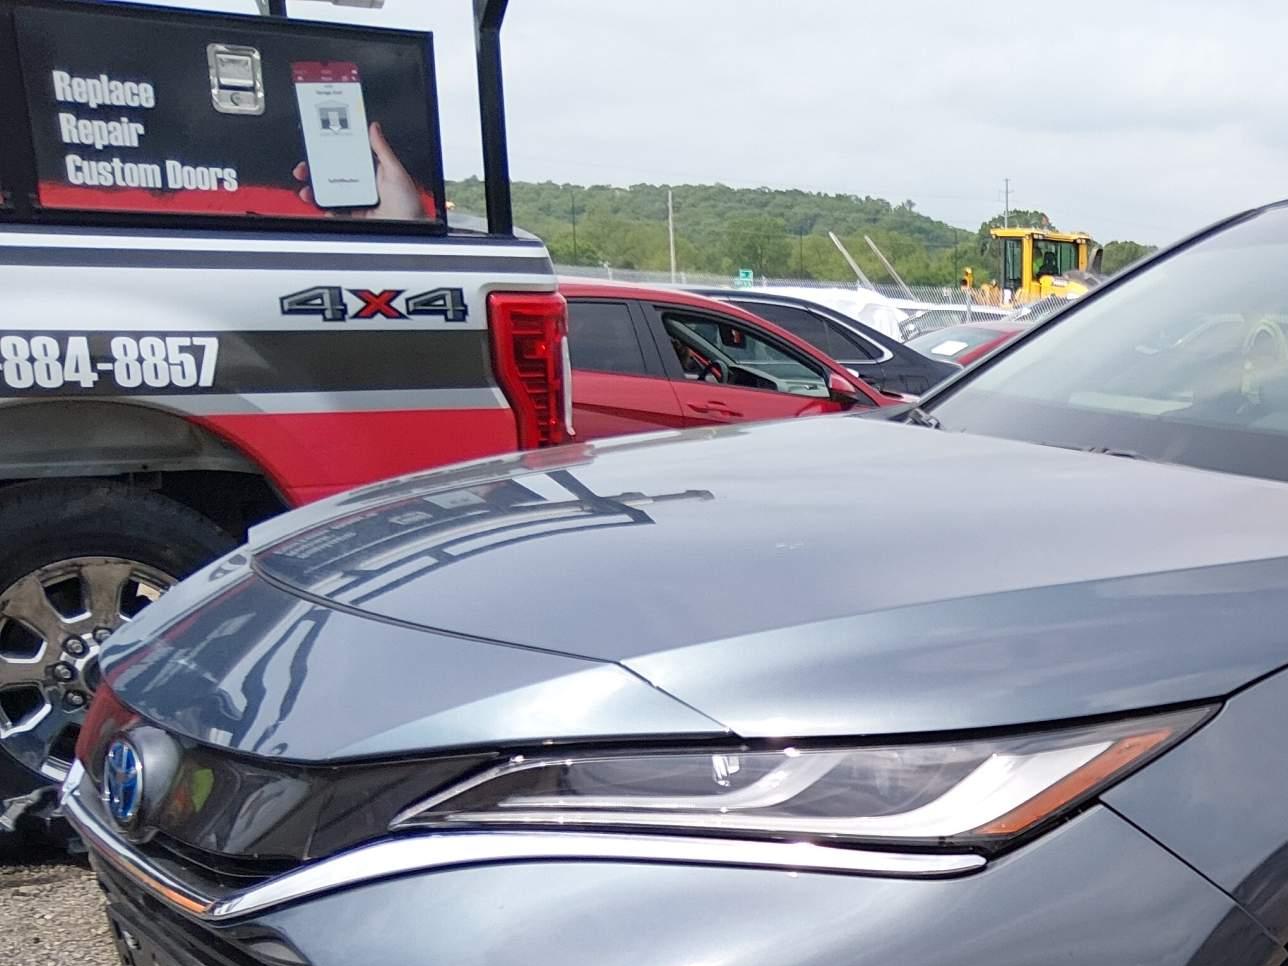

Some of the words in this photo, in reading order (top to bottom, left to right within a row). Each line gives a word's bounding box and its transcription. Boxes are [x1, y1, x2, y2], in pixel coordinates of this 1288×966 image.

[53, 70, 156, 109] Replace
[59, 112, 145, 150] Repair
[65, 154, 162, 189] Custom
[165, 159, 239, 193] Doors
[0, 335, 220, 390] 884-8857
